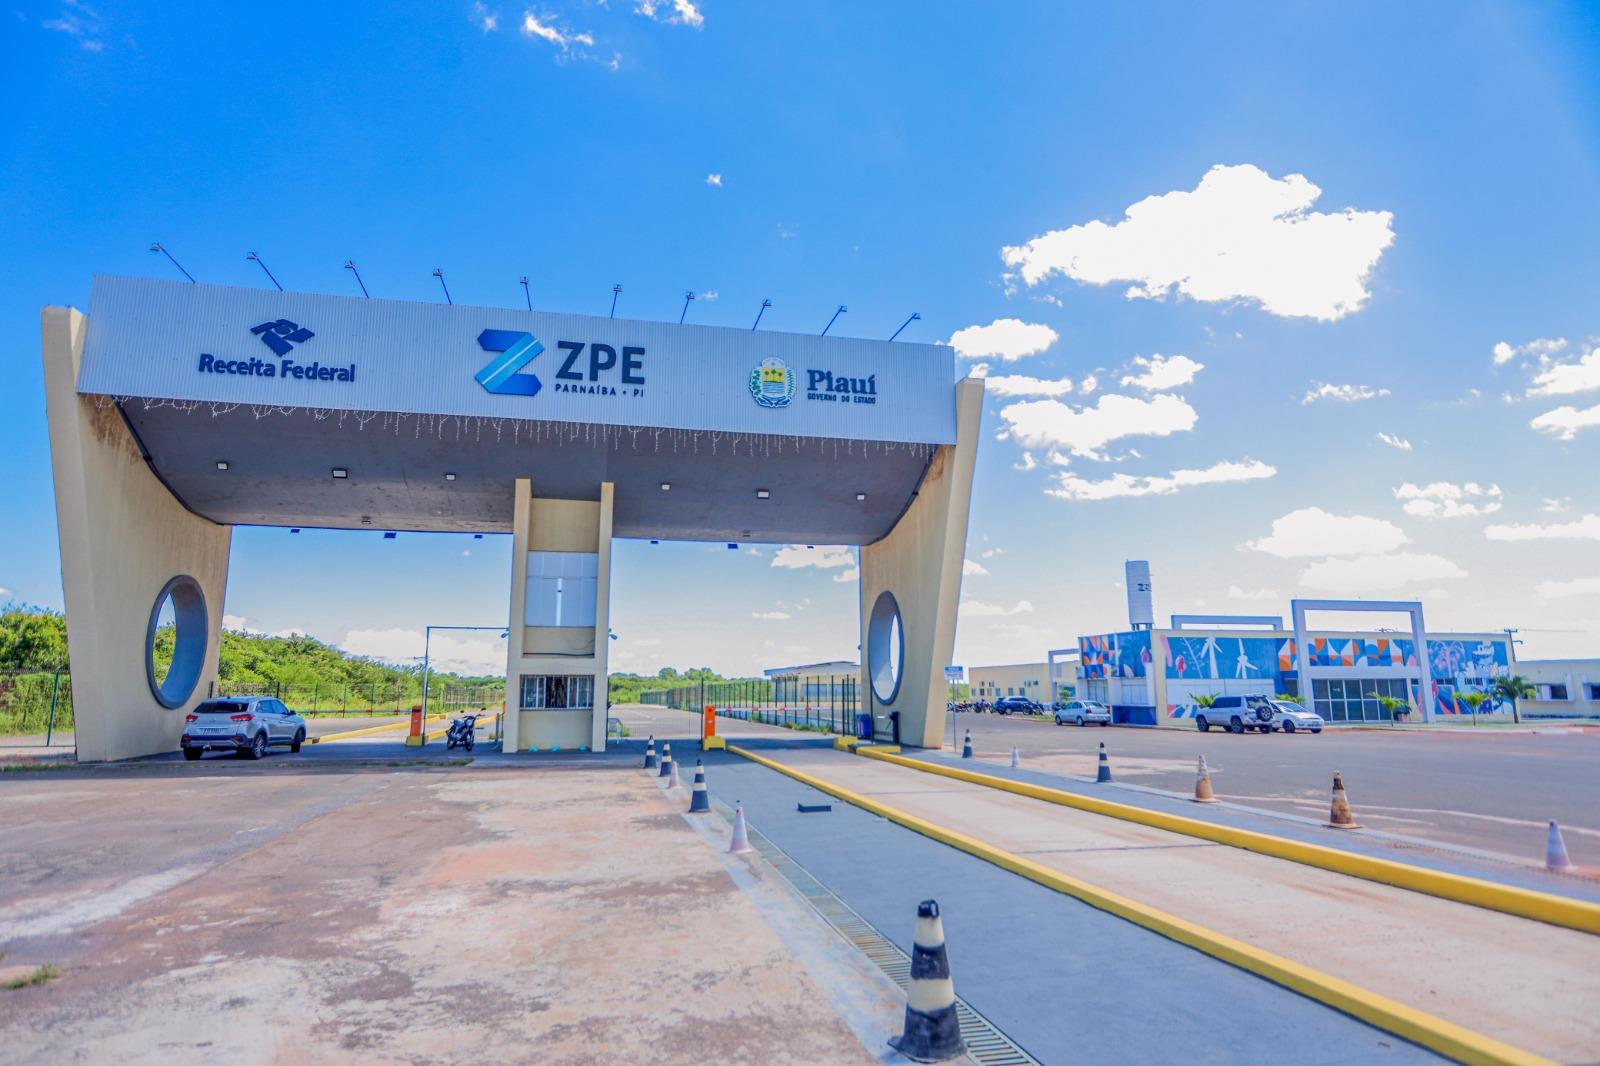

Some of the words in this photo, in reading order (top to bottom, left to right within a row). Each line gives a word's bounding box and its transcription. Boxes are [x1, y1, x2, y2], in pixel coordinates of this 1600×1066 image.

[198, 353, 276, 378] Receita
[281, 359, 356, 383] Federal
[555, 340, 646, 384] ZPE
[555, 383, 617, 396] PARNAÍBA
[633, 387, 645, 398] PI
[807, 370, 876, 394] Piauí
[807, 393, 836, 402] GOVERNO
